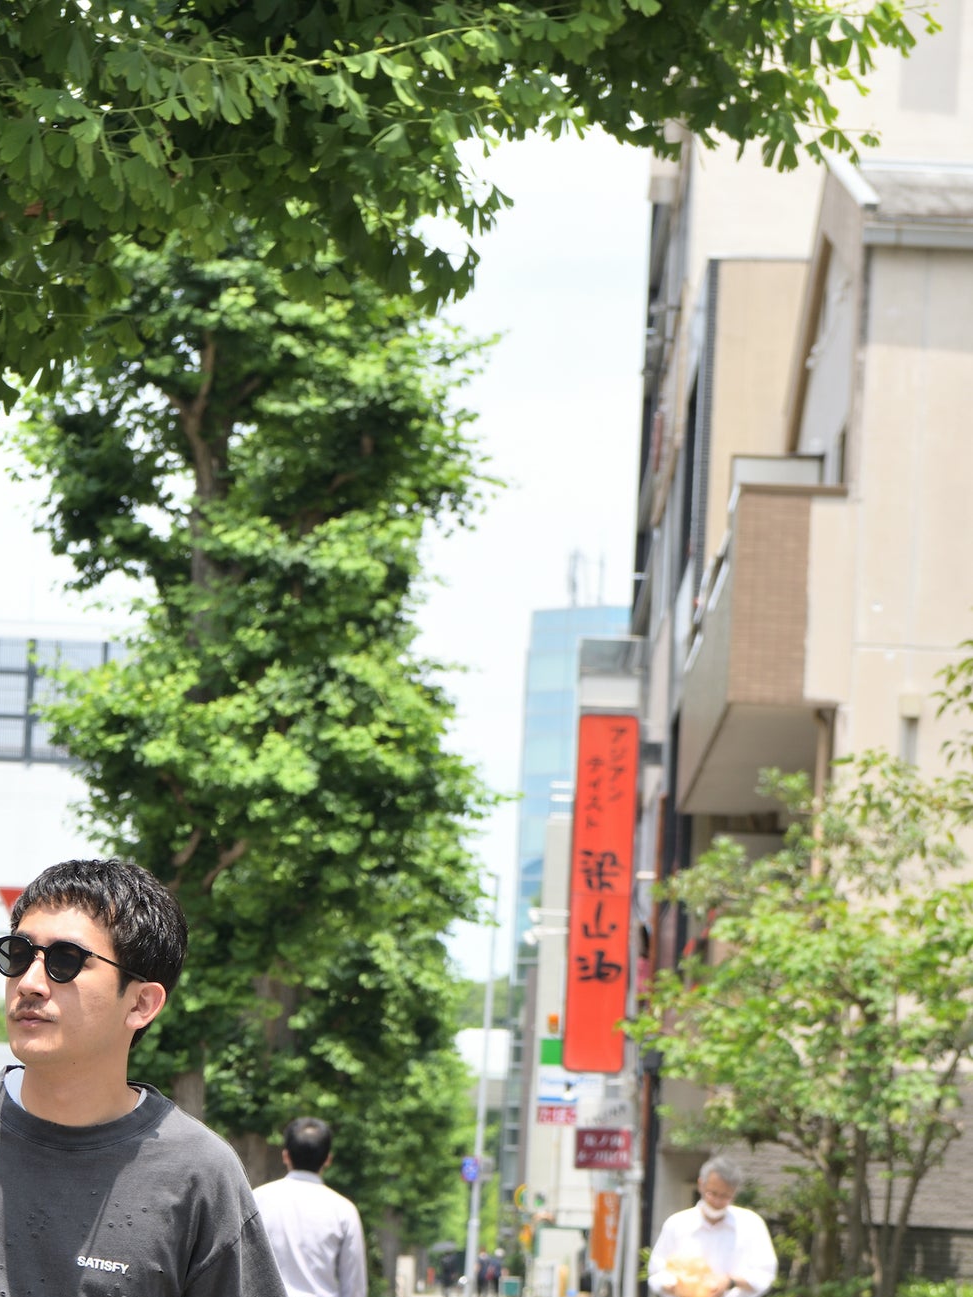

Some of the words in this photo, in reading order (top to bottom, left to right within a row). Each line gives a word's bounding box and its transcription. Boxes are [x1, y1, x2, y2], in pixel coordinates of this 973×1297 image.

[608, 725, 628, 802] アジアン
[576, 850, 624, 983] 梁山泊
[77, 1256, 129, 1275] SATISFY
